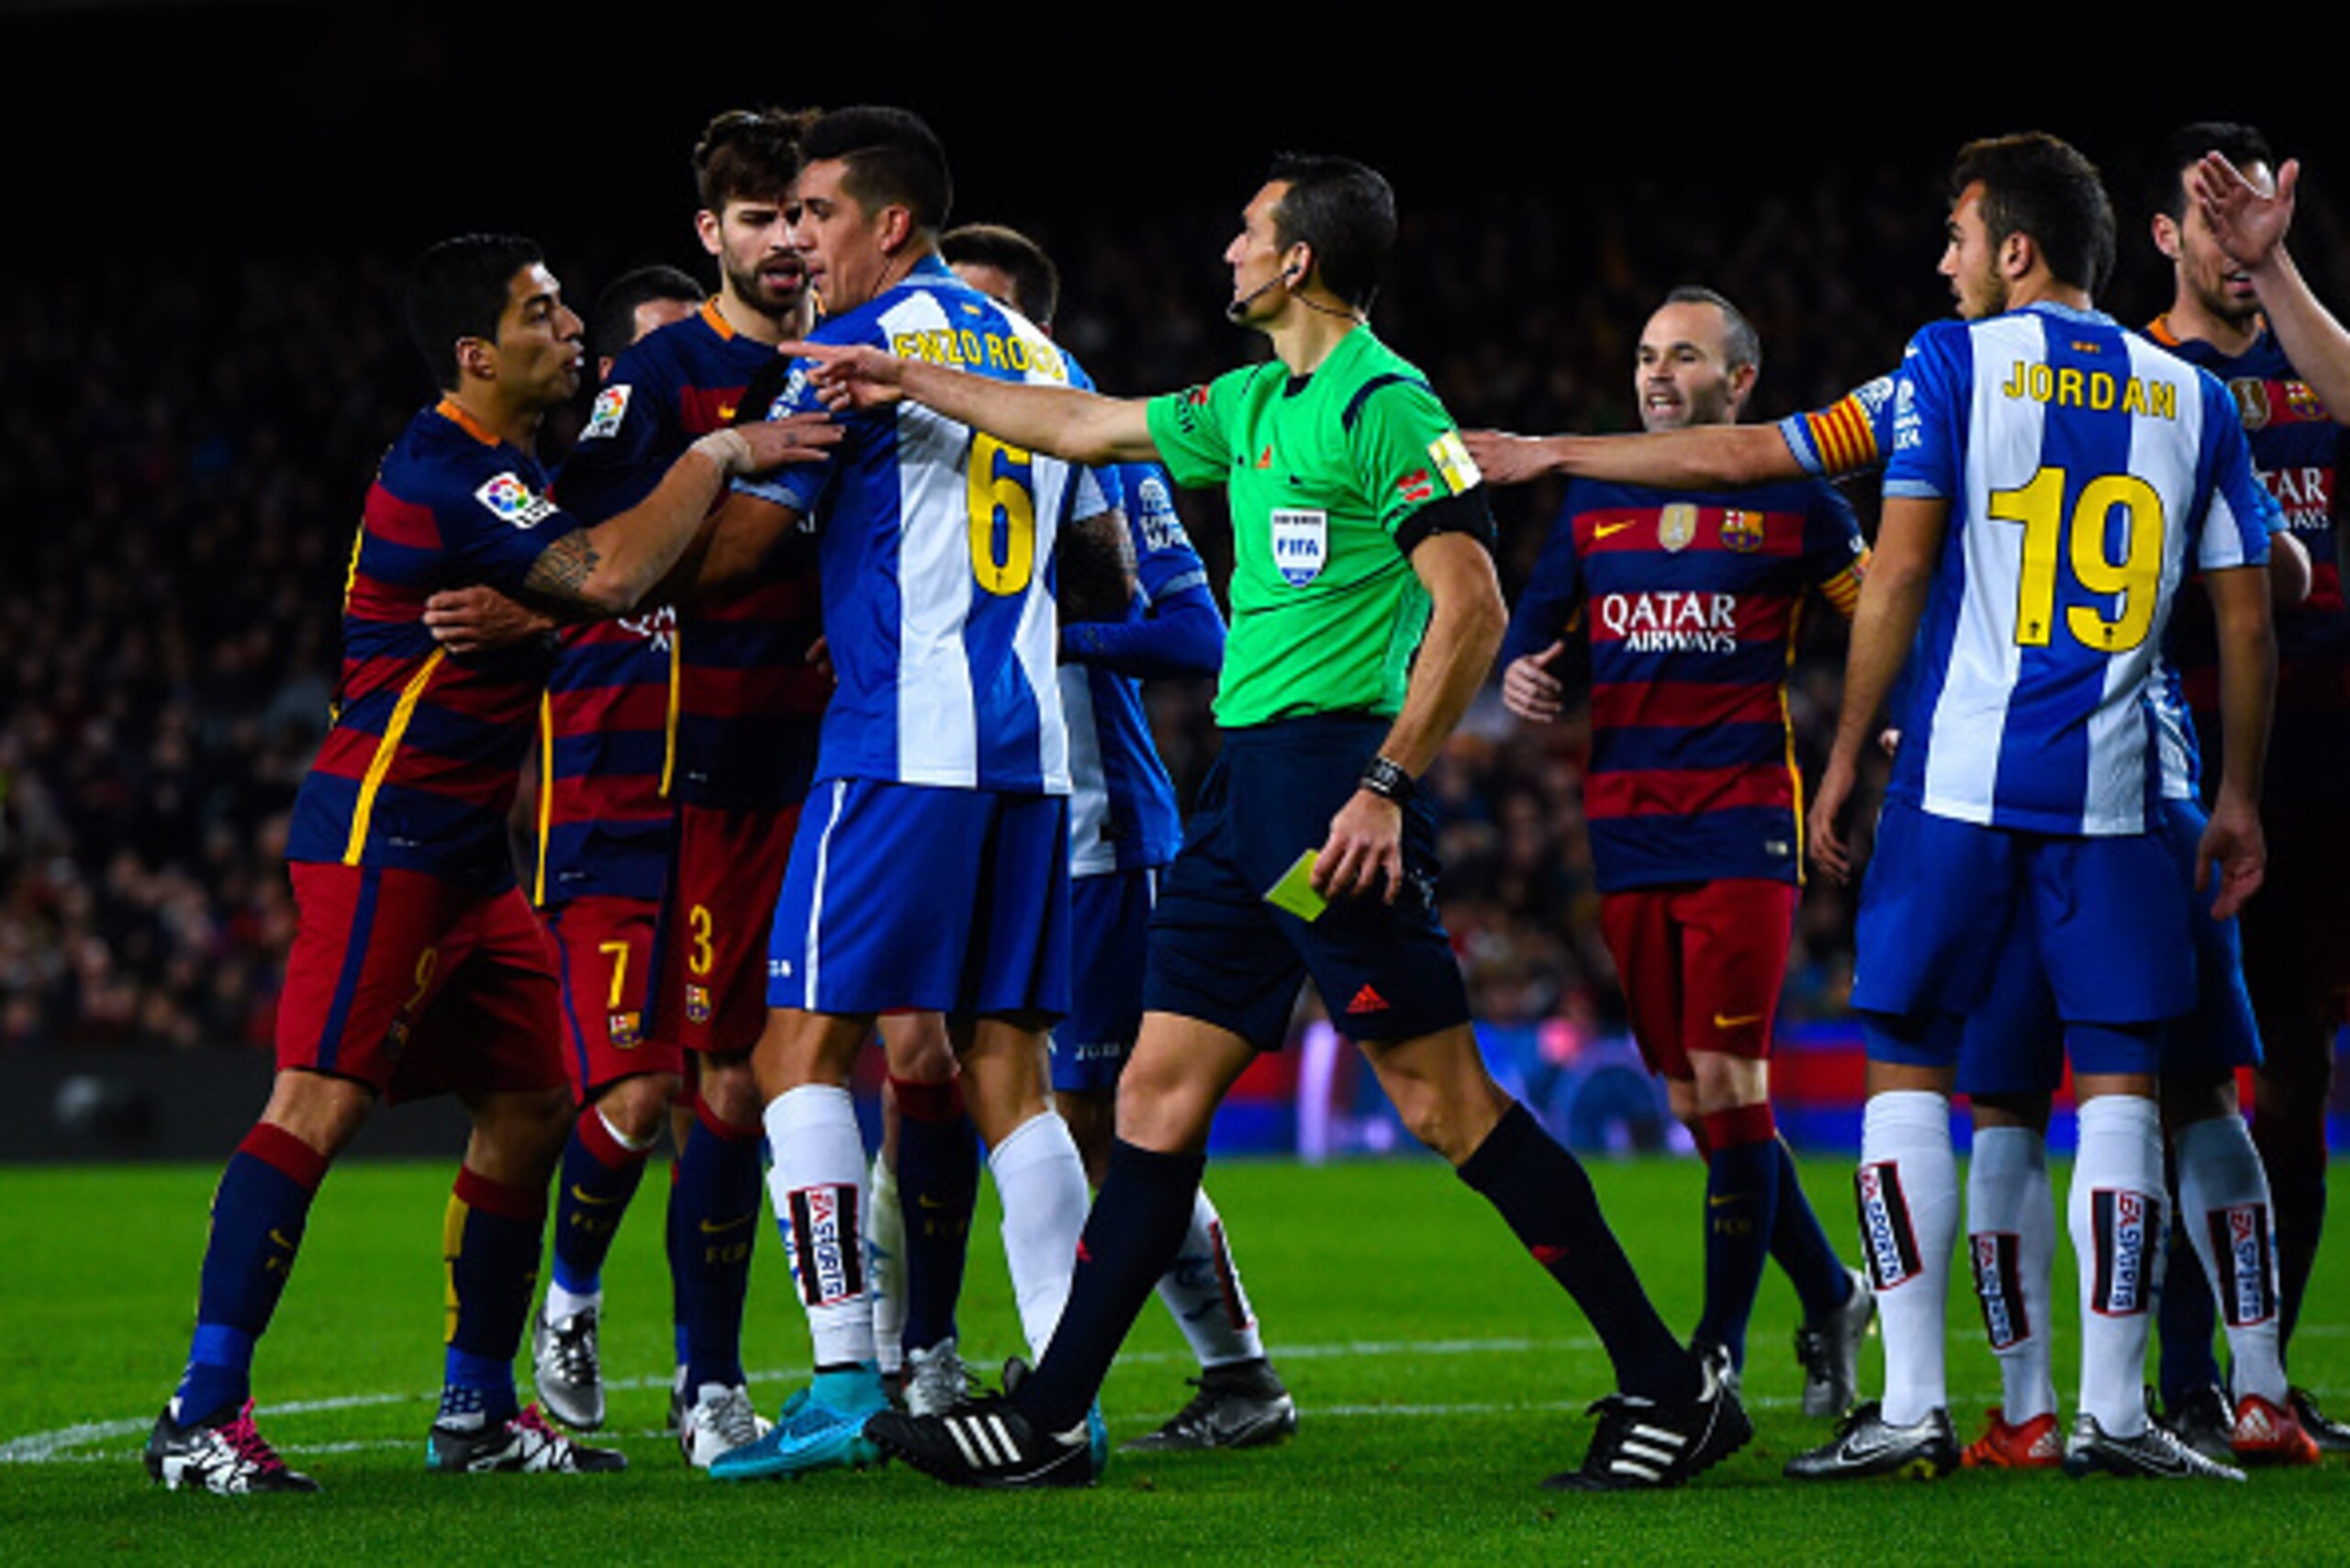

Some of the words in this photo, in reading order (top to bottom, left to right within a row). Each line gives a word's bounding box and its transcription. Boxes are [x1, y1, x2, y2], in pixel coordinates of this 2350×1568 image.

[893, 328, 982, 365] ENZO
[2002, 360, 2177, 421] JORDAN
[967, 431, 1035, 597] 6
[1277, 538, 1319, 557] FIFA
[1988, 466, 2165, 654] 19
[1602, 590, 1737, 637] QATAR
[1624, 629, 1737, 655] AIRWAYS
[689, 904, 712, 975] 3
[599, 941, 629, 1009] 7
